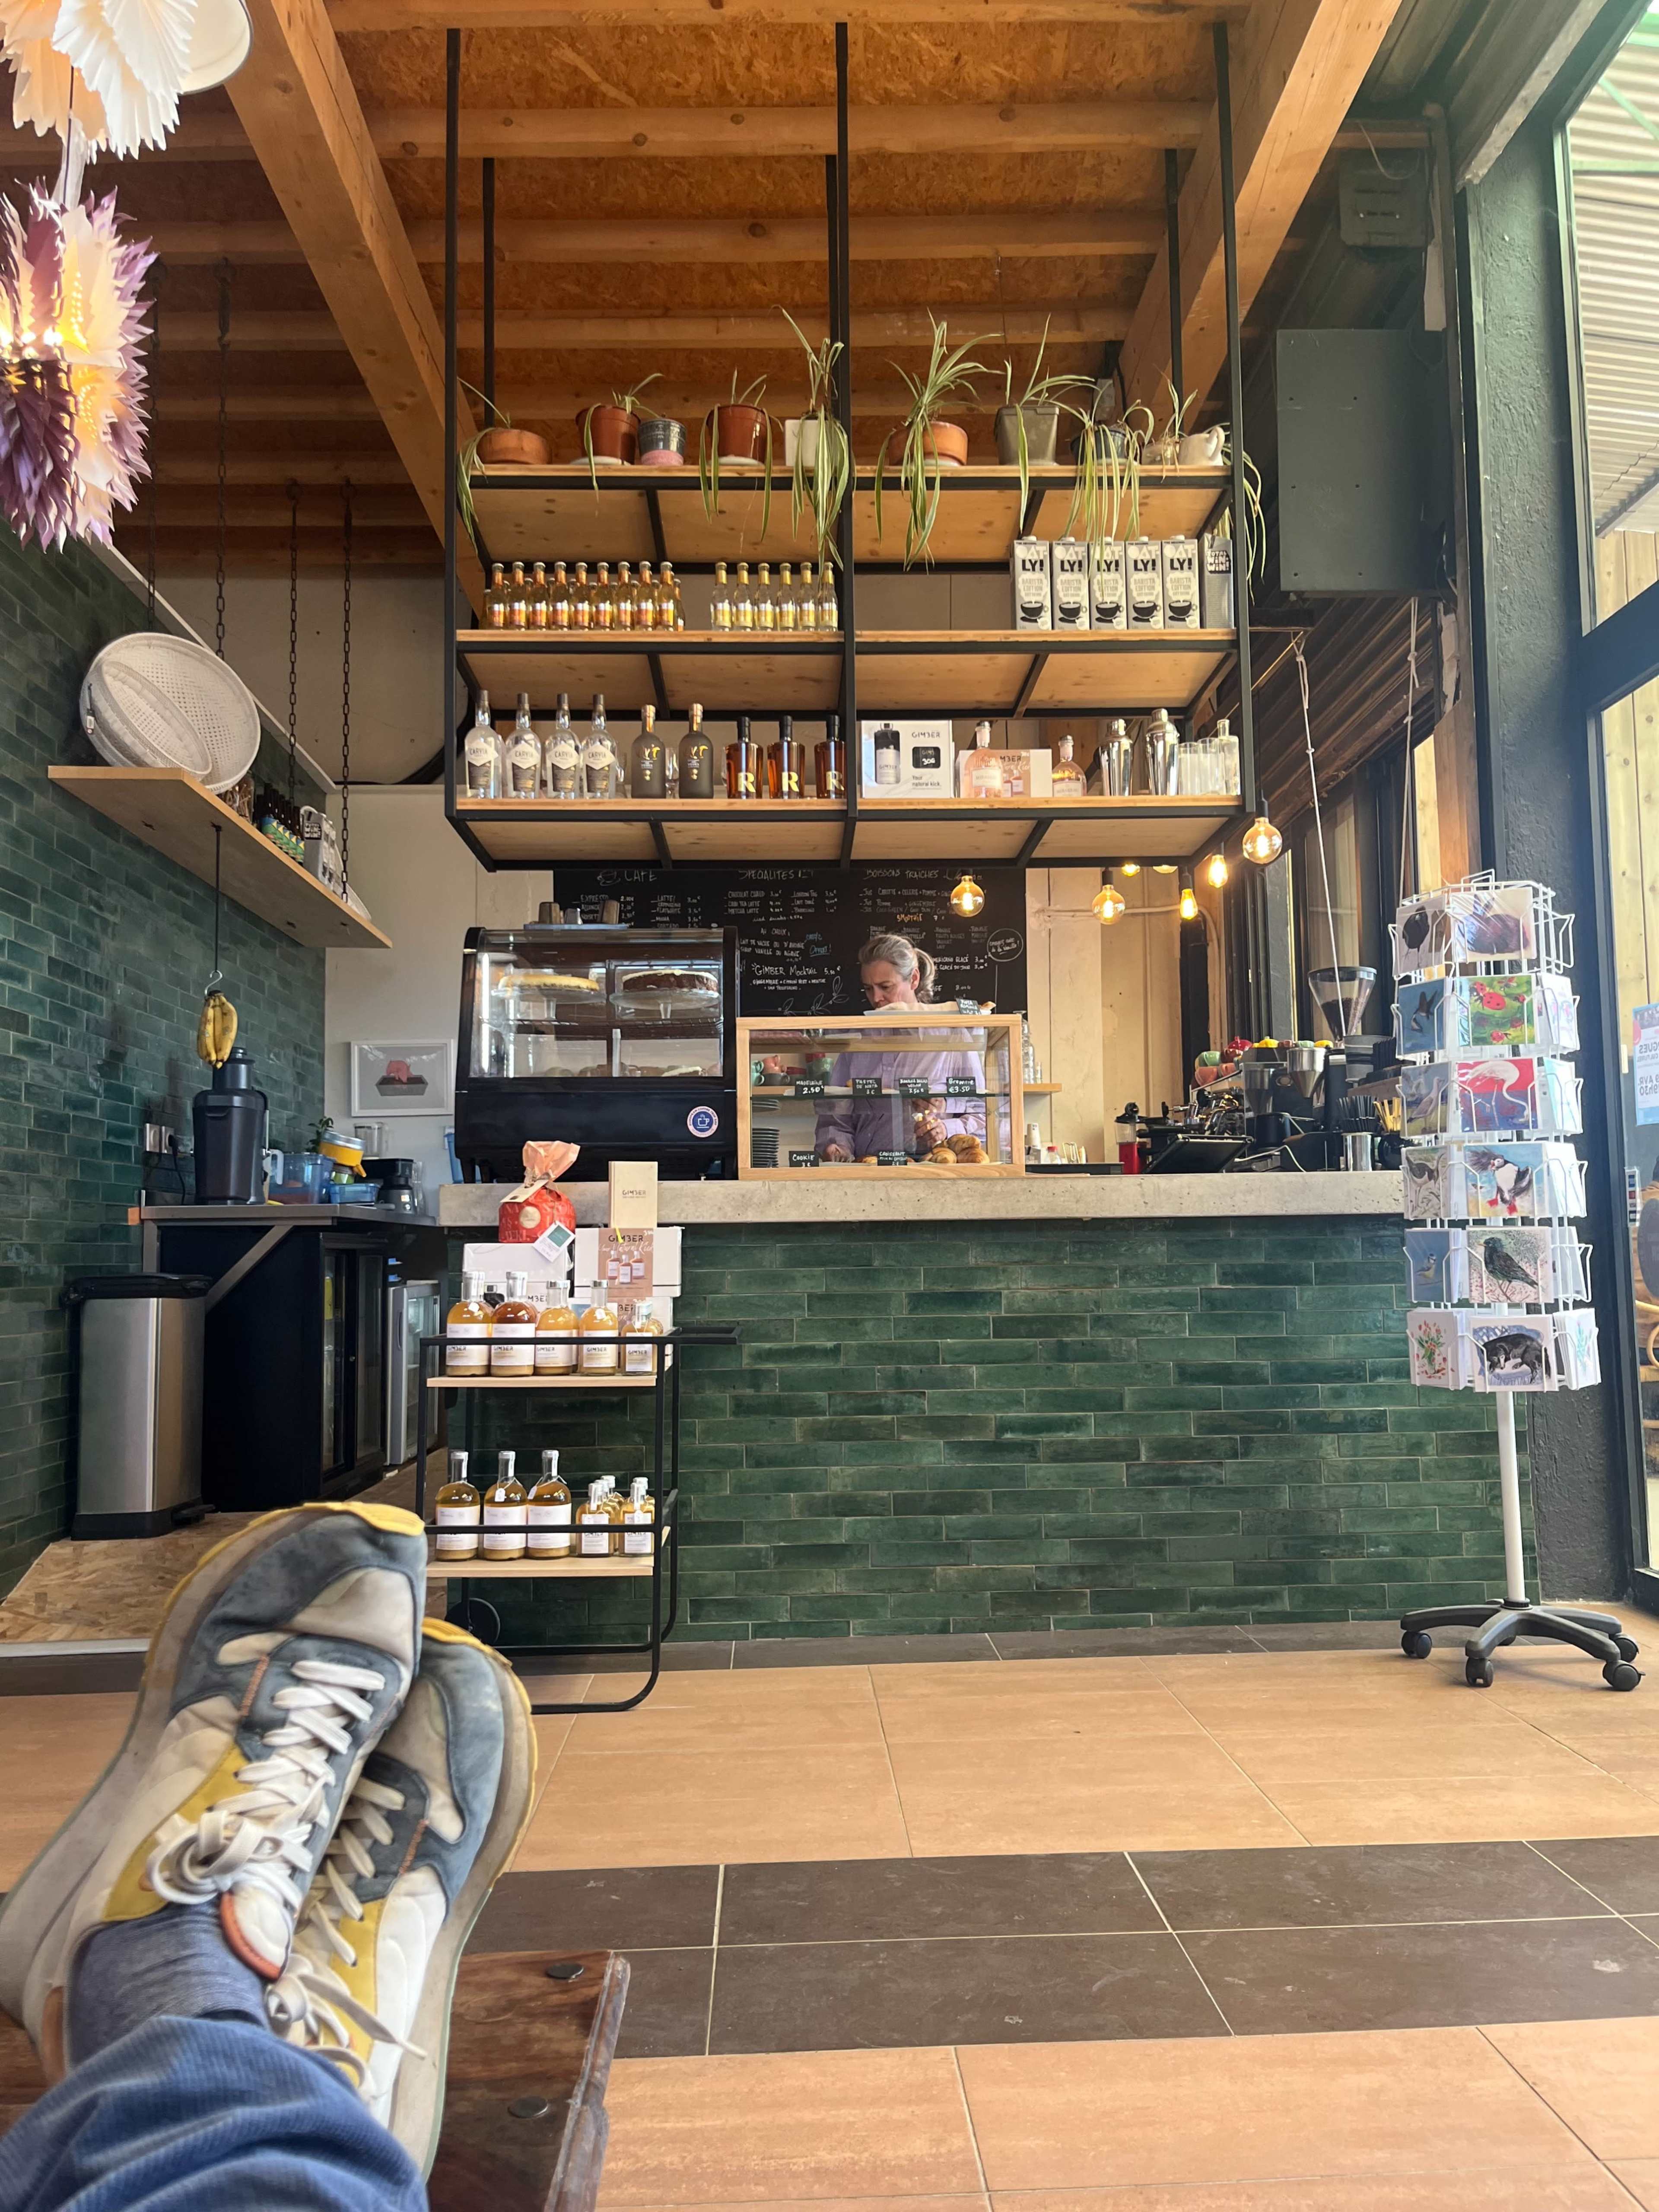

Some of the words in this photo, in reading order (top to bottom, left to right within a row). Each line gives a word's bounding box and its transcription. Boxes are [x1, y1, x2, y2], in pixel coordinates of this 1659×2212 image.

[1022, 559, 1044, 572] LY!
[1060, 560, 1082, 572] LY!
[1134, 559, 1156, 572] LY!
[1170, 558, 1192, 571] LY!
[737, 772, 756, 792] R
[782, 771, 799, 792] R
[826, 771, 844, 791] R
